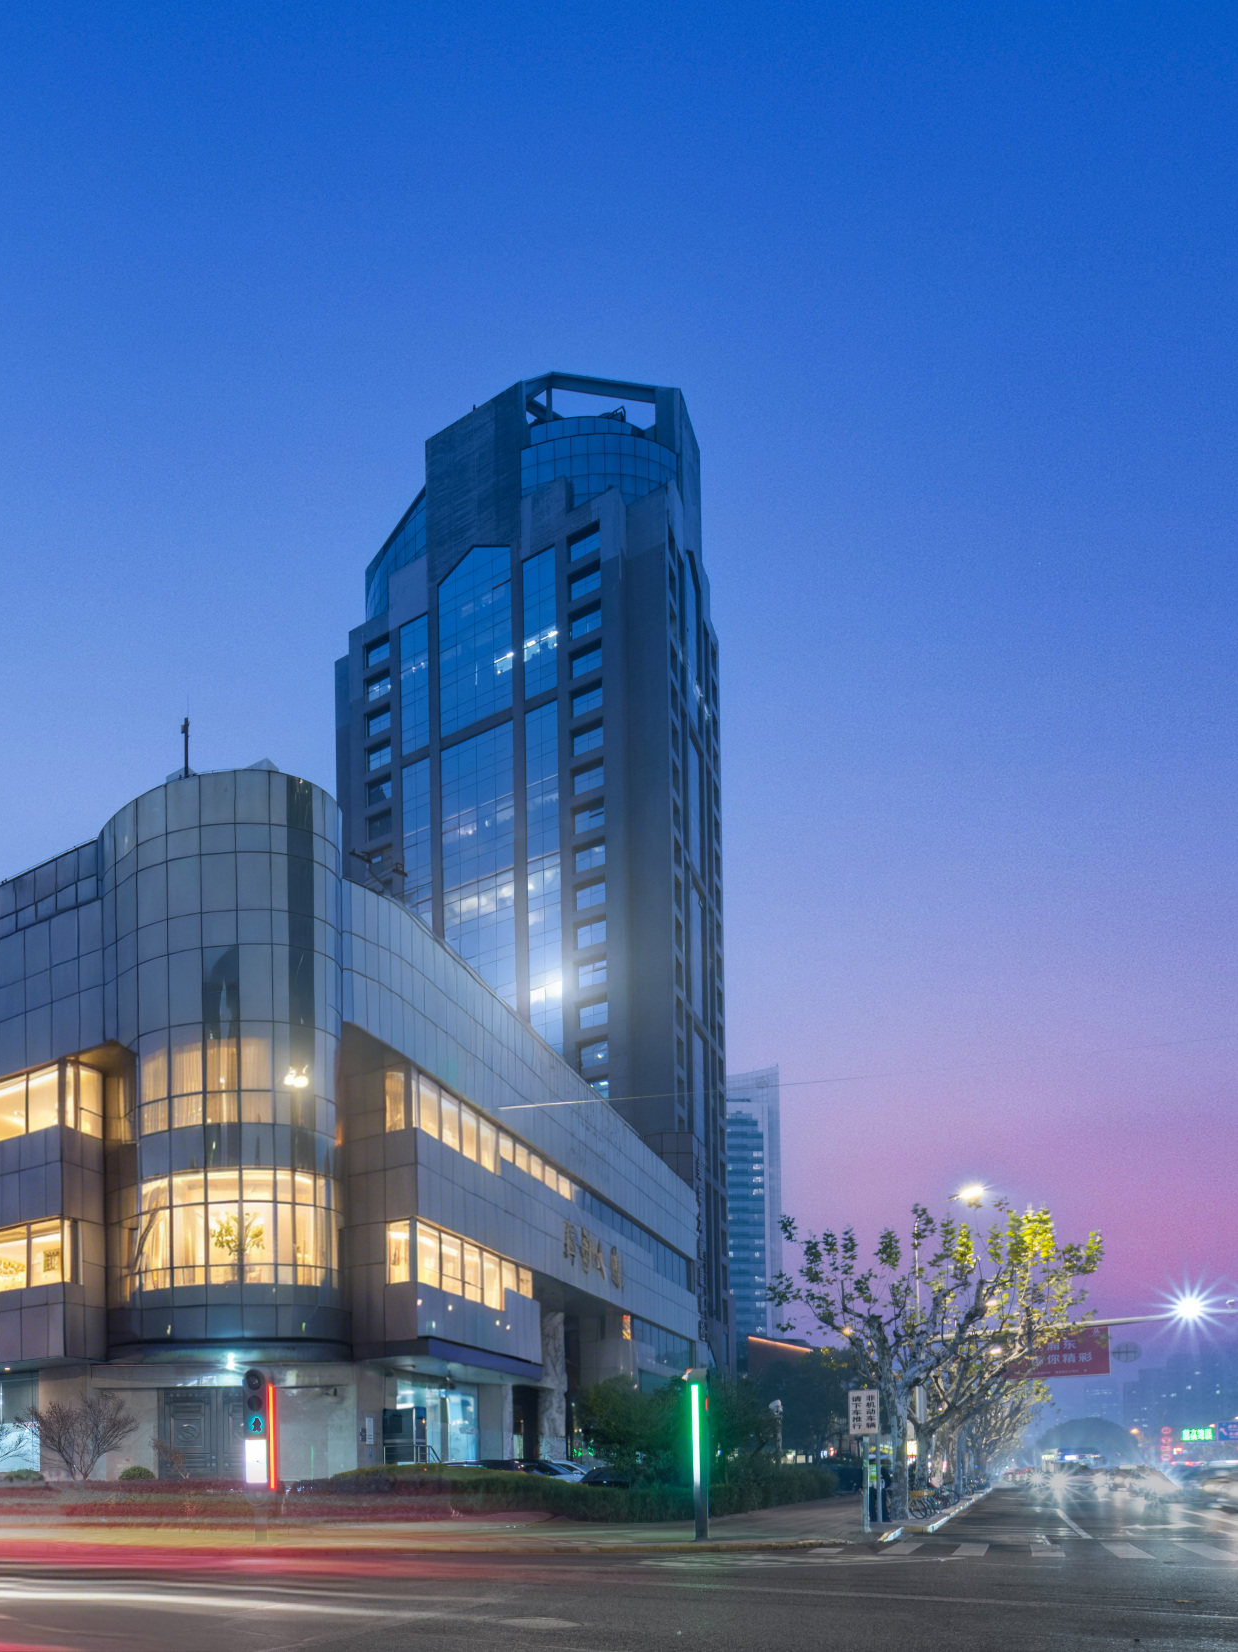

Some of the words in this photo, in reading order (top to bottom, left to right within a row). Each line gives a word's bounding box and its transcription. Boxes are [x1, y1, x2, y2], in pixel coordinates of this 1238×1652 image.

[852, 1395, 862, 1430] 请下车推行
[866, 1394, 876, 1429] 非机动车辆
